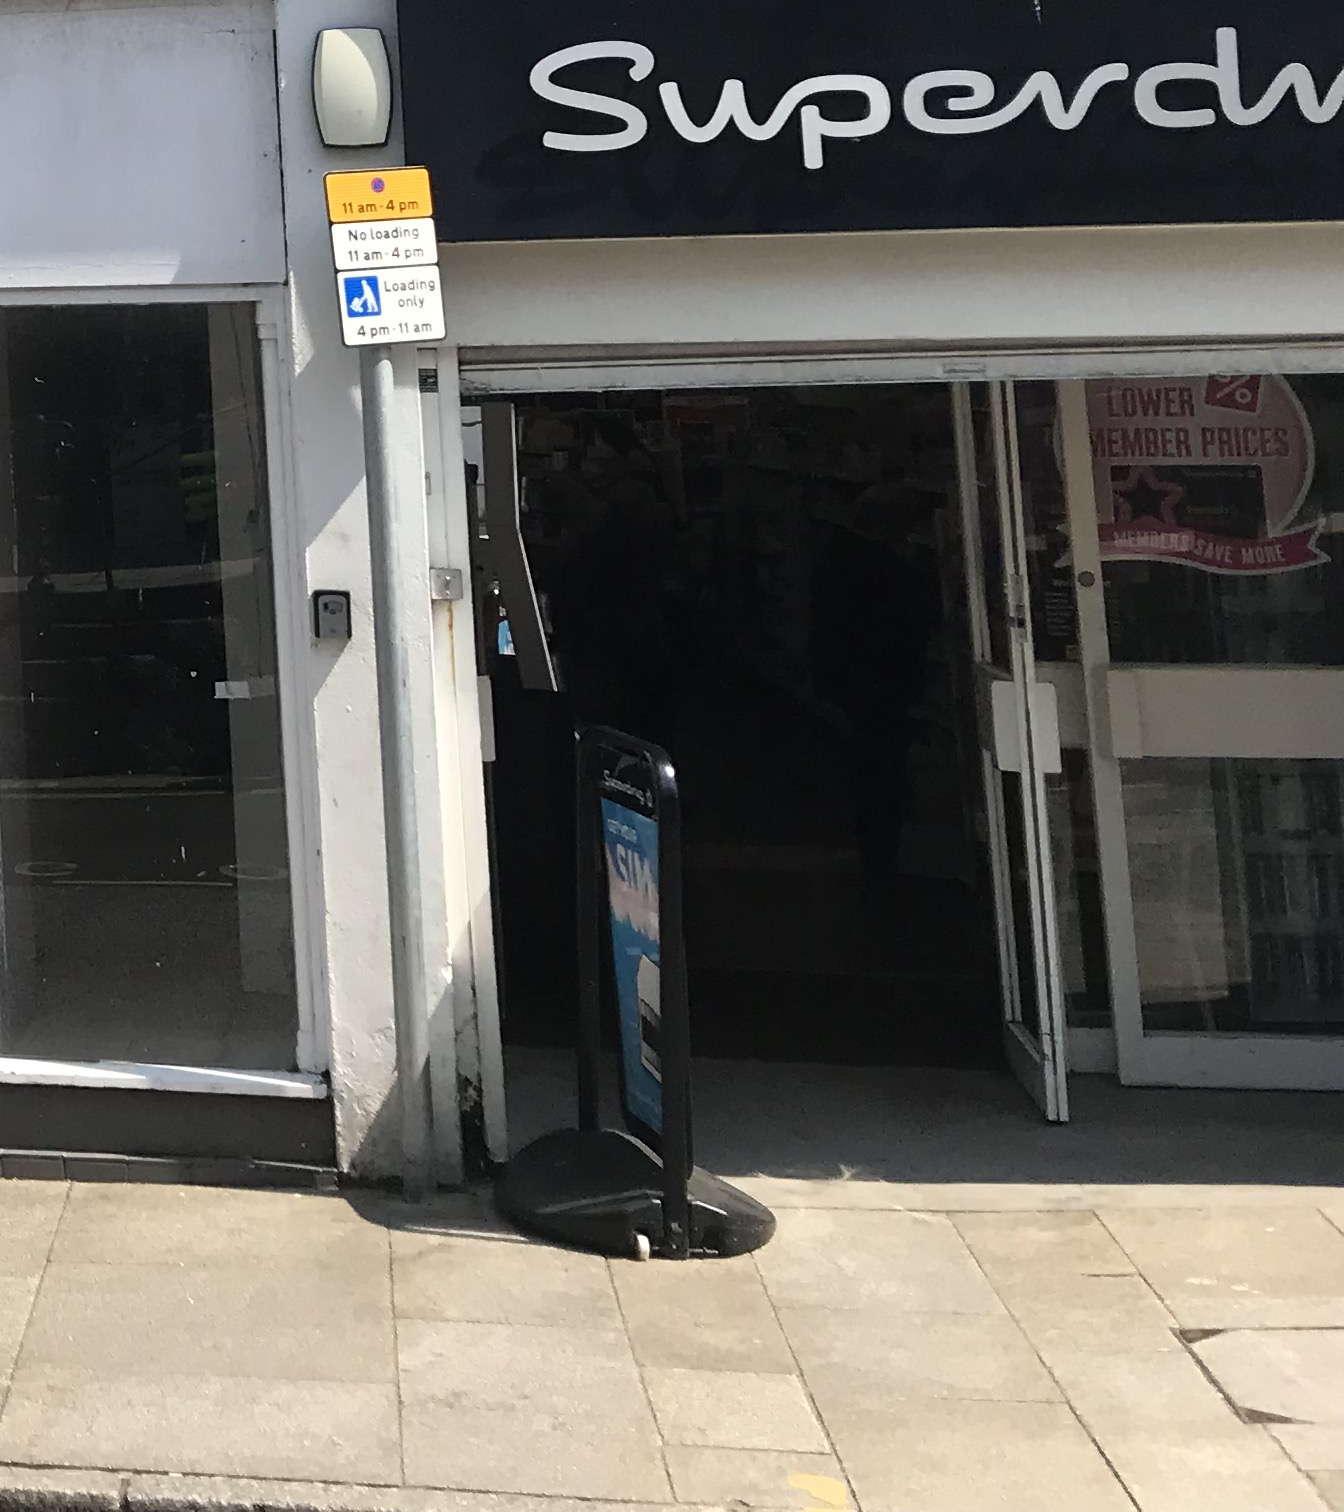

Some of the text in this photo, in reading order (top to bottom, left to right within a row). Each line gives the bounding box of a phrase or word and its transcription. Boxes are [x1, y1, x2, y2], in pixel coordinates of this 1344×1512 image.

[342, 202, 353, 214] 11
[399, 200, 419, 213] pm
[348, 226, 419, 241] No loading
[348, 250, 359, 262] 11
[404, 248, 424, 260] pm
[384, 278, 436, 292] Loading
[398, 295, 425, 308] only
[398, 322, 409, 334] 11
[413, 322, 432, 333] am
[1107, 386, 1195, 417] LOWER
[1201, 427, 1291, 458] PRICES
[1193, 538, 1286, 565] SAVE MORE
